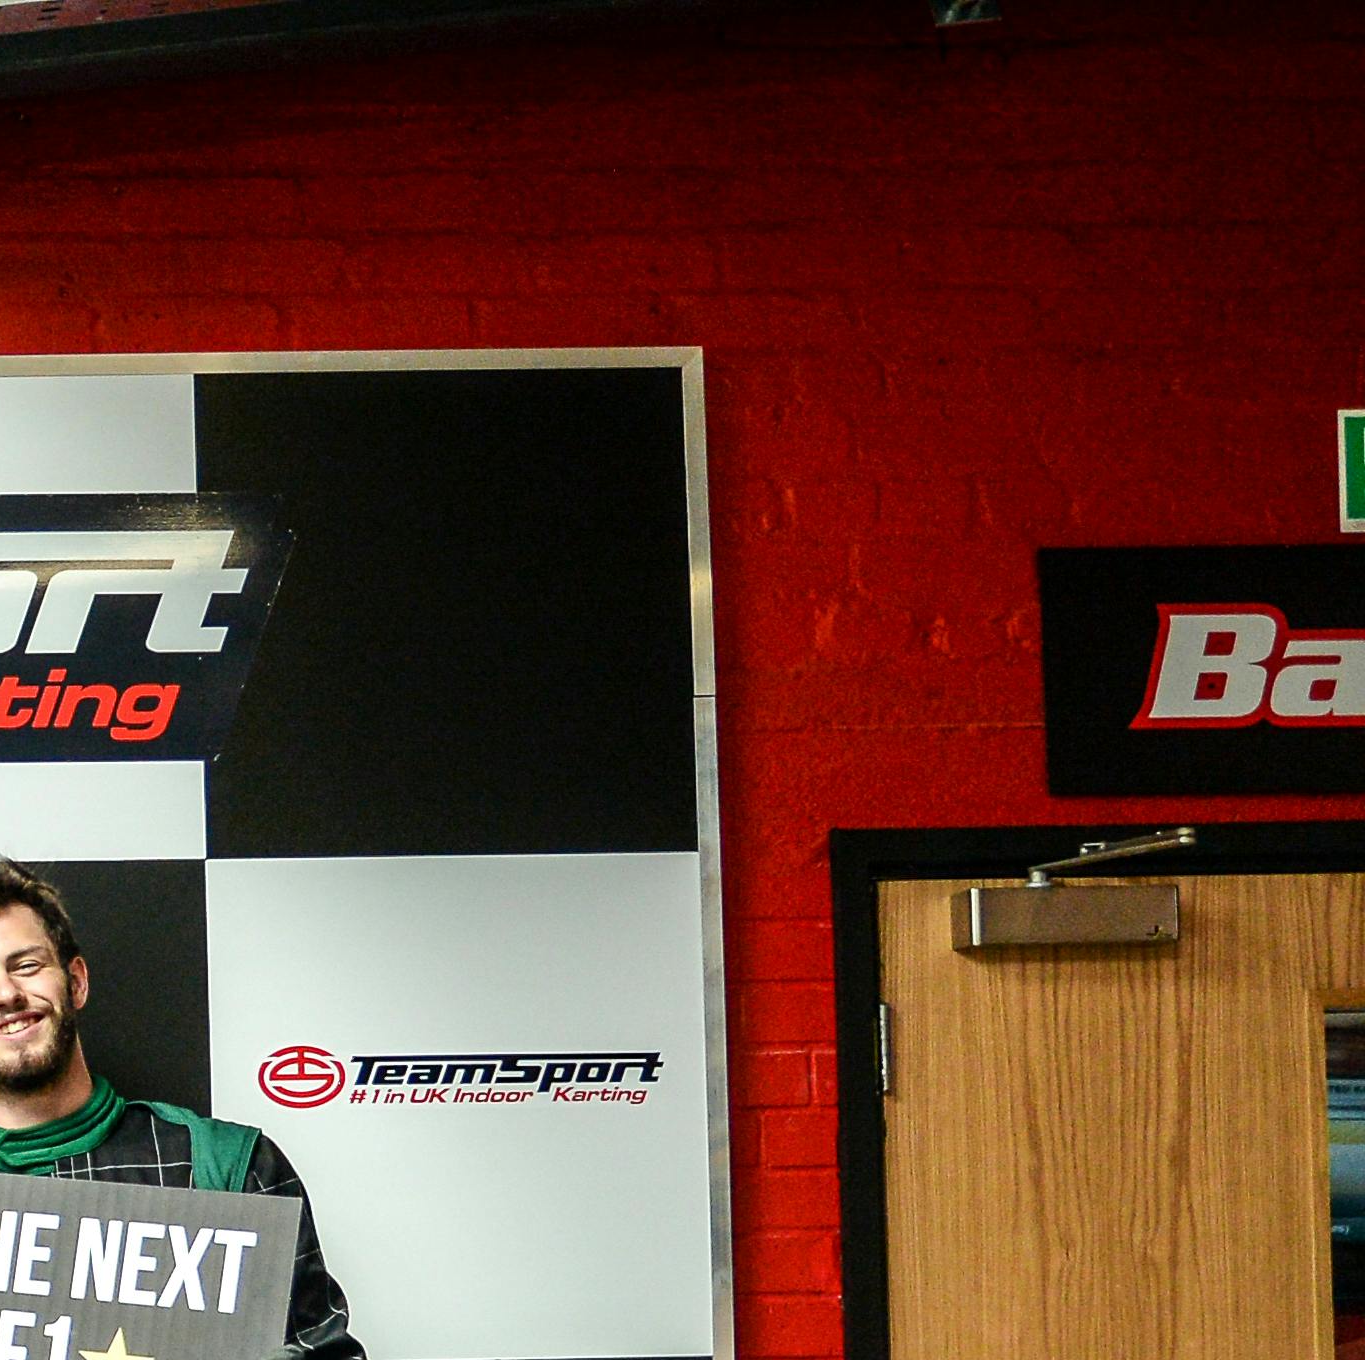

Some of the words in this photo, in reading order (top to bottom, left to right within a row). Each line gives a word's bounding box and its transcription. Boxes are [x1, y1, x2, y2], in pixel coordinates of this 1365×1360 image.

[350, 1052, 664, 1093] TeamSport
[410, 1088, 451, 1104] UK
[453, 1088, 534, 1104] Indoor
[552, 1086, 648, 1105] Karting
[69, 1217, 258, 1315] NEXT
